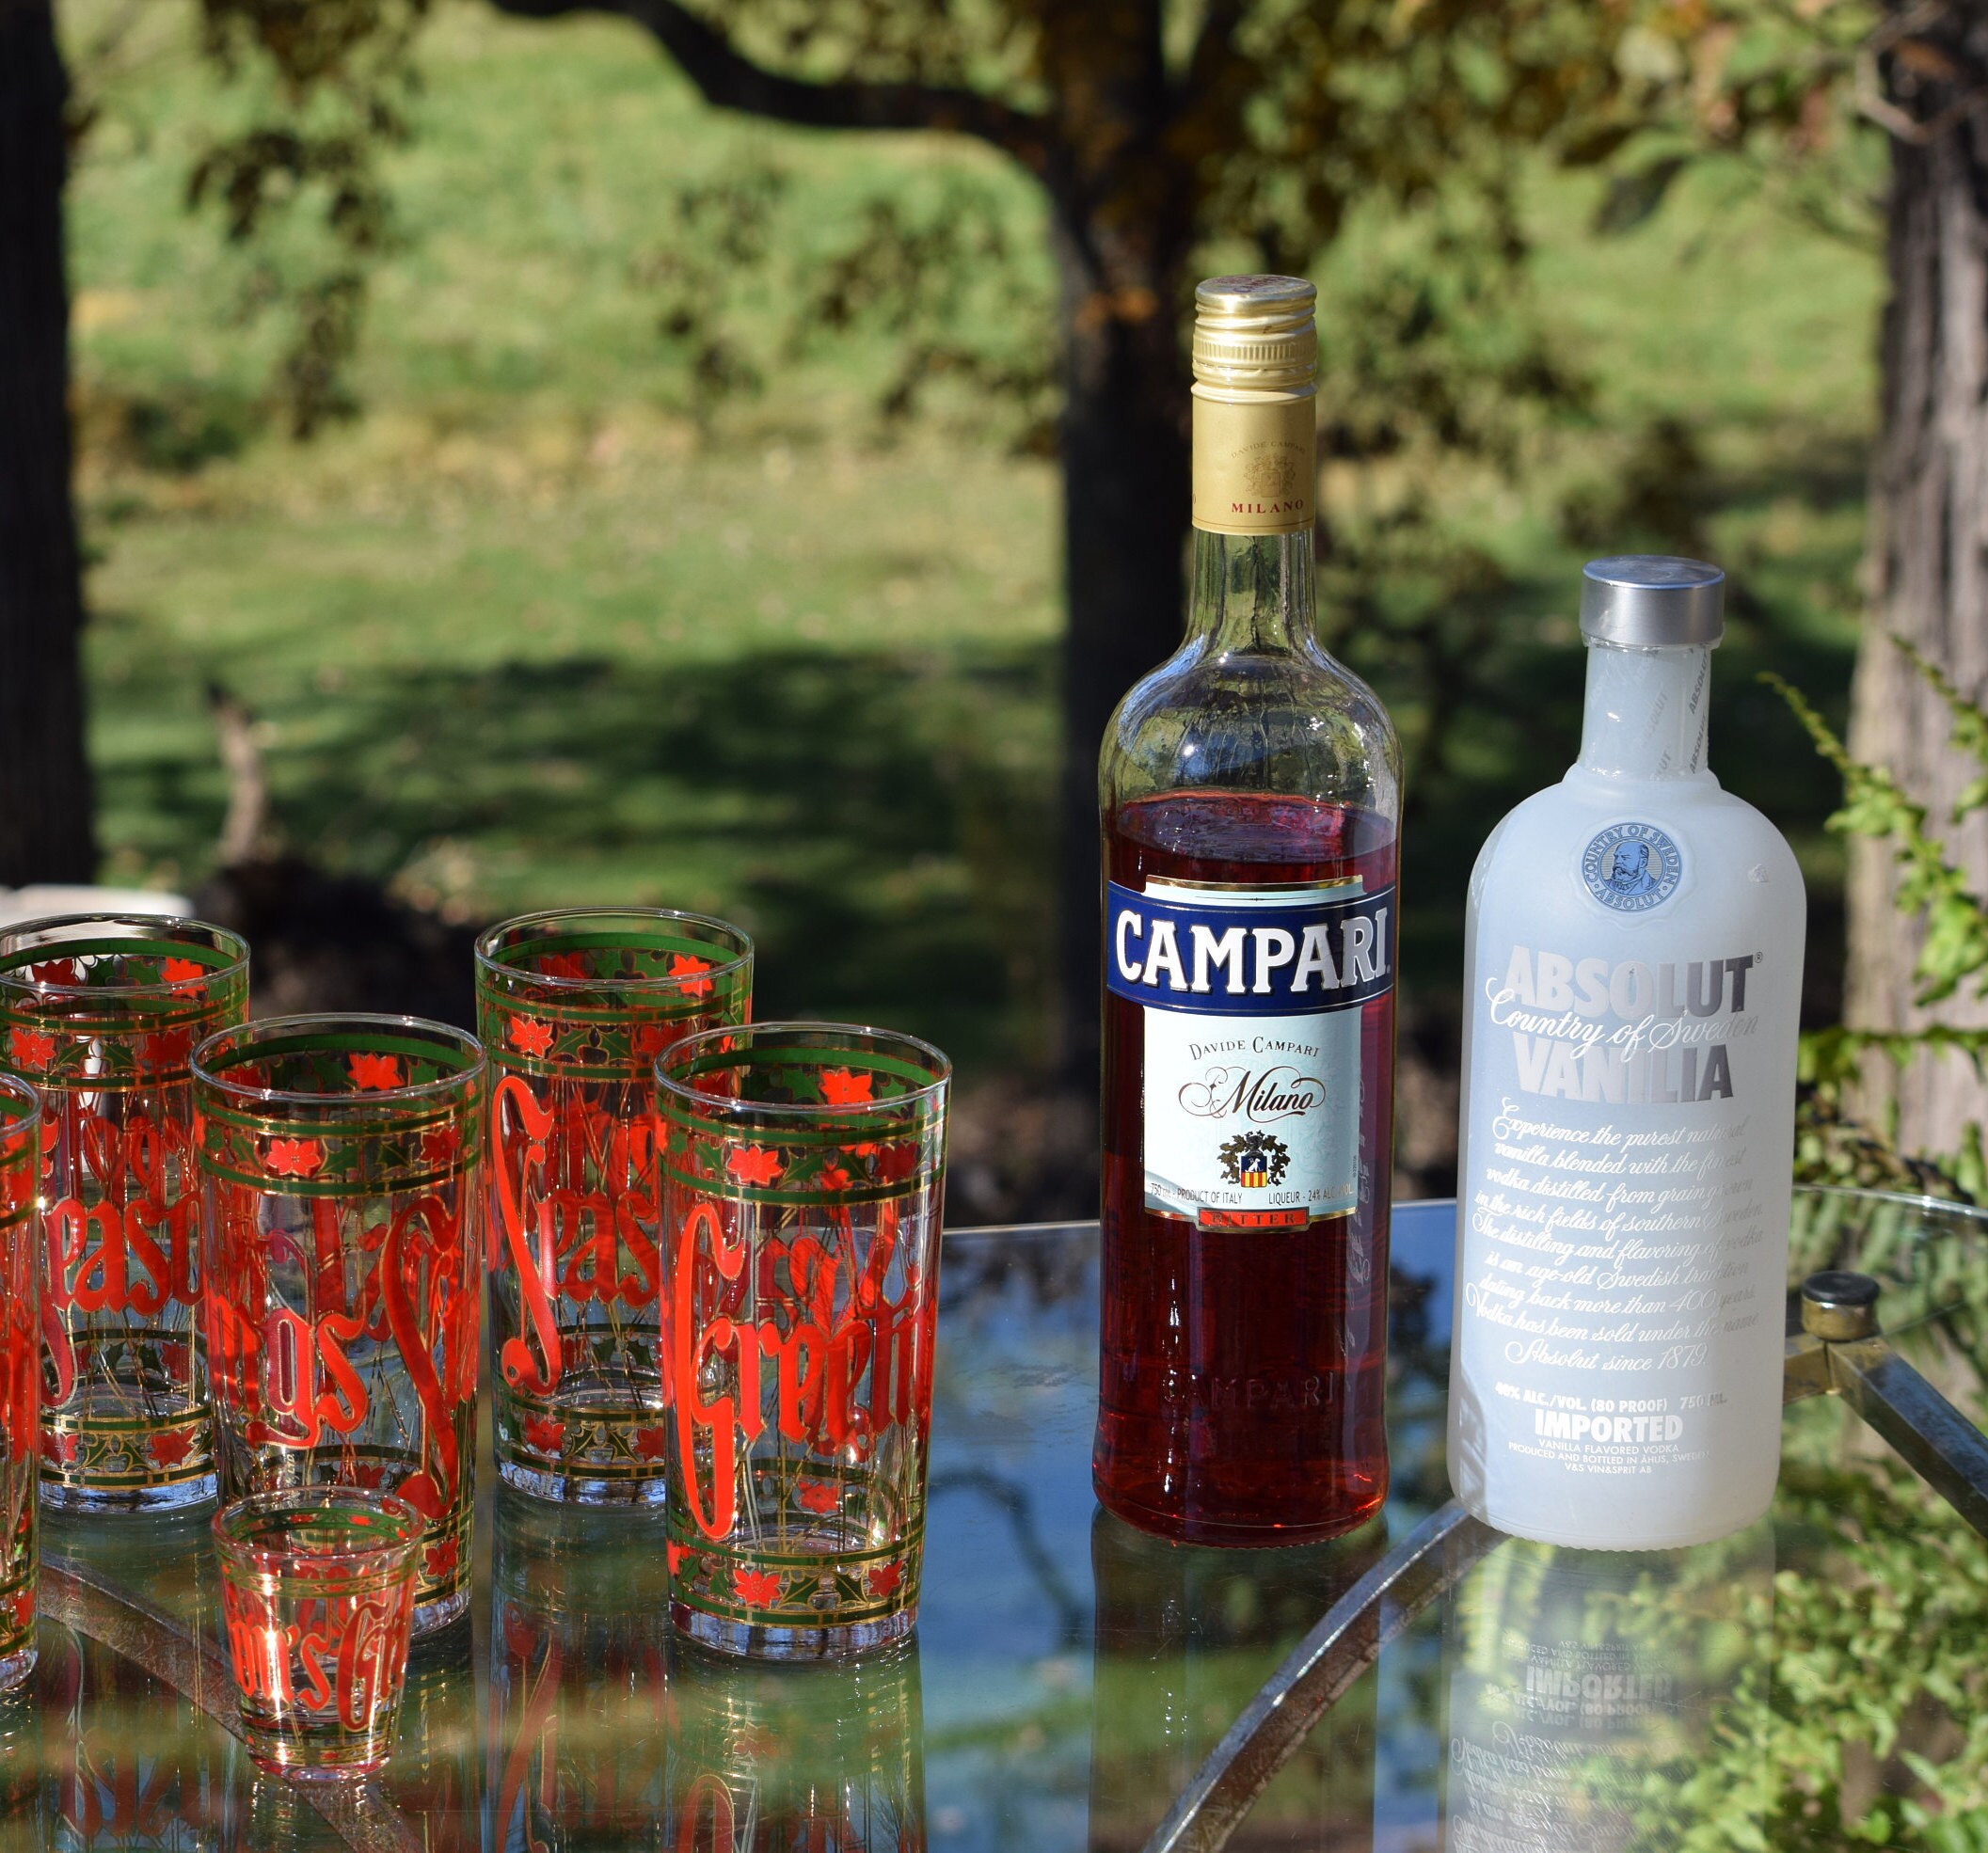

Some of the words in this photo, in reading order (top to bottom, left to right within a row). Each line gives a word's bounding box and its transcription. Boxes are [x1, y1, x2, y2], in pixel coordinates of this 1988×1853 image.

[1231, 499, 1305, 514] MILANO
[1584, 825, 1624, 883] COUNTRY
[1627, 825, 1648, 837] OF
[1649, 830, 1679, 886] SWEDEN
[1594, 886, 1664, 911] ABSOLUT
[1116, 907, 1389, 993] CAMPARI
[1485, 976, 1606, 1061] Country
[1605, 1013, 1656, 1064] of
[1195, 1066, 1326, 1123] Milano
[1492, 1097, 1590, 1144] Experience
[1588, 1125, 1622, 1146] the
[1619, 1127, 1687, 1153] purest
[1494, 1142, 1551, 1167] vanilla
[1549, 1149, 1628, 1174] blended
[1628, 1153, 1668, 1175] with
[1668, 1151, 1697, 1174] the
[1151, 1182, 1162, 1196] 750
[1176, 1188, 1208, 1203] PRODUCT
[1210, 1191, 1220, 1203] OF
[1222, 1192, 1243, 1205] ITALY
[1268, 1190, 1301, 1206] LIQUEUR
[1308, 1188, 1321, 1202] 24%
[1487, 1167, 1531, 1191] vodka
[1529, 1175, 1605, 1202] distilled
[1605, 1182, 1655, 1213] from
[1650, 1185, 1705, 1213] grain
[1212, 1212, 1295, 1225] BITTER
[1474, 1190, 1489, 1207] in
[1488, 1193, 1511, 1214] the
[1511, 1203, 1547, 1224] rich
[1545, 1206, 1598, 1233] fields
[1598, 1212, 1627, 1242] of
[1621, 1212, 1701, 1232] southern
[1472, 1206, 1503, 1239] The
[1499, 1225, 1576, 1266] distilling
[1573, 1240, 1615, 1260] and
[1614, 1238, 1703, 1270] flavoring
[1485, 1251, 1501, 1267] is
[1500, 1259, 1524, 1274] an
[1525, 1265, 1598, 1289] age-old
[1597, 1265, 1680, 1290] Swedish
[1478, 1273, 1527, 1308] dating
[1527, 1287, 1573, 1310] back
[1573, 1298, 1624, 1314] more
[1621, 1294, 1667, 1314] than
[1668, 1289, 1718, 1313] 400
[1466, 1282, 1514, 1327] Vodka
[1512, 1310, 1547, 1334] has
[1544, 1317, 1588, 1340] been
[1590, 1322, 1635, 1343] sold
[1637, 1321, 1692, 1343] under
[1694, 1317, 1722, 1339] the
[1505, 1338, 1600, 1370] Absolut
[1601, 1353, 1654, 1371] since
[1494, 1381, 1520, 1402] 40%
[1590, 1396, 1615, 1413] (80
[1618, 1397, 1668, 1413] PROOF)
[1678, 1394, 1705, 1410] 750
[1535, 1408, 1683, 1443] IMPORTED
[1508, 1441, 1555, 1459] PRODUCED
[1558, 1450, 1580, 1462] AND
[1582, 1453, 1624, 1465] BOTTLED
[1626, 1454, 1638, 1465] IN
[1538, 1438, 1582, 1454] VANILLA
[1584, 1444, 1639, 1455] FLAVORED
[1643, 1444, 1679, 1454] VODKA
[1565, 1462, 1584, 1473] V&S
[1587, 1465, 1637, 1475] VIN&SPRIT
[1639, 1465, 1652, 1475] AB
